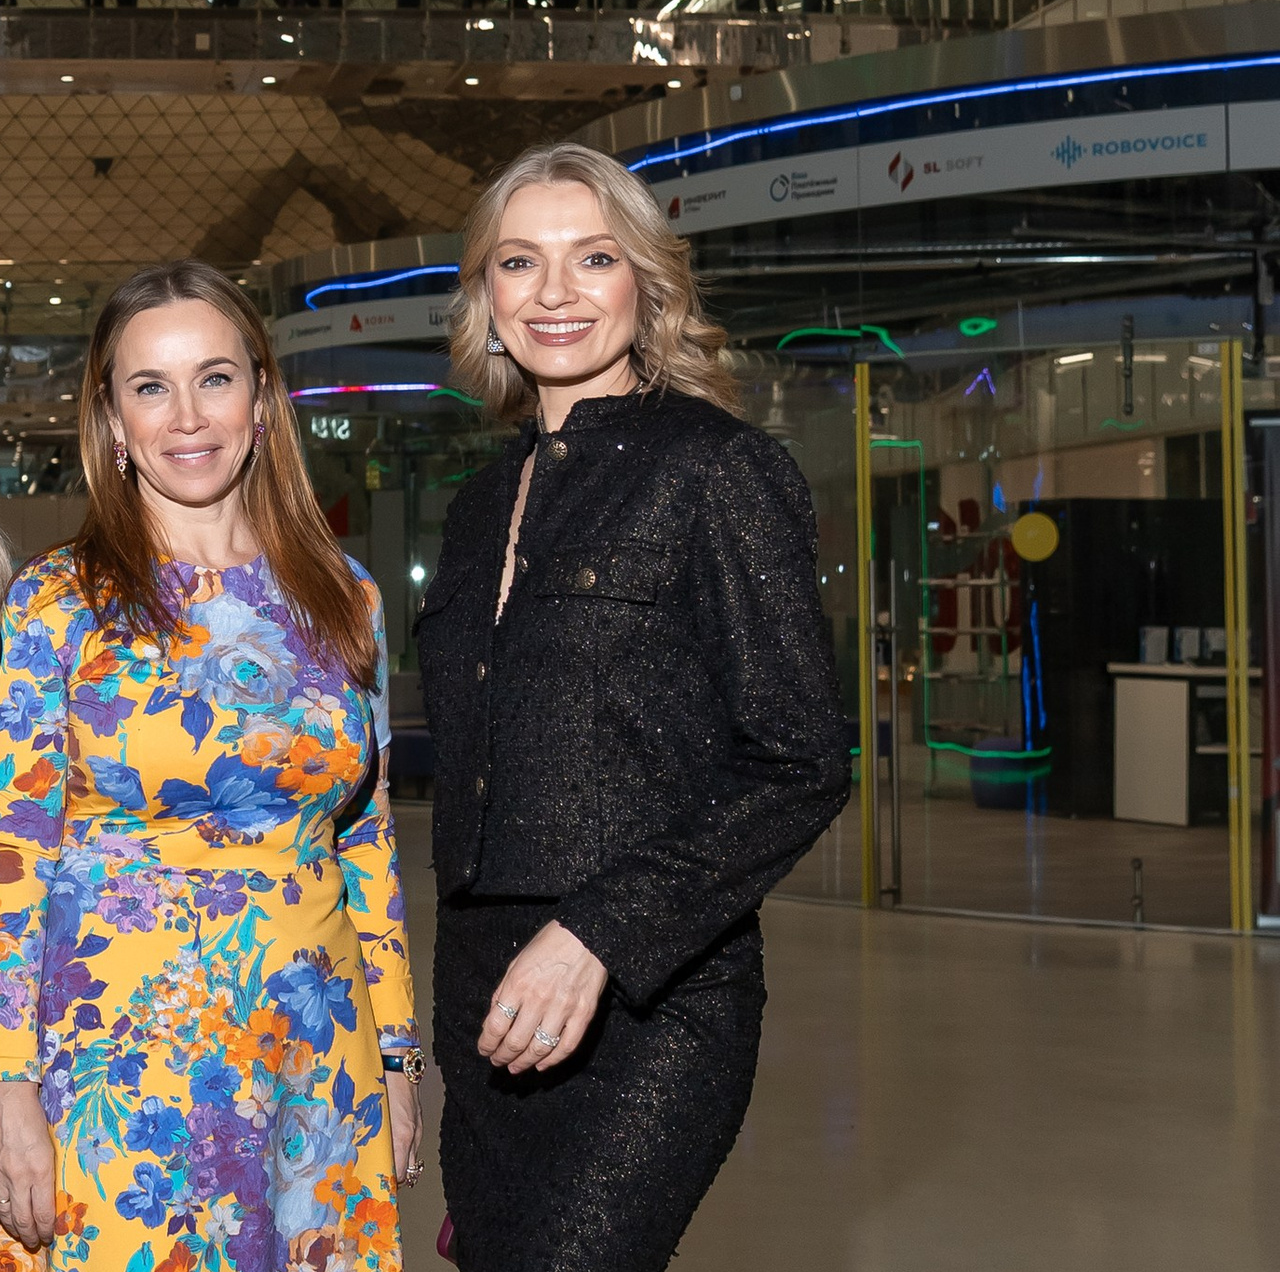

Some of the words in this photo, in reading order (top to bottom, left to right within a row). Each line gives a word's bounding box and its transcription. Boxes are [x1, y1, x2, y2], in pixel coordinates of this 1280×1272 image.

[1091, 133, 1208, 157] ROBOVOICE
[923, 161, 941, 174] SL
[945, 155, 984, 173] SOFT
